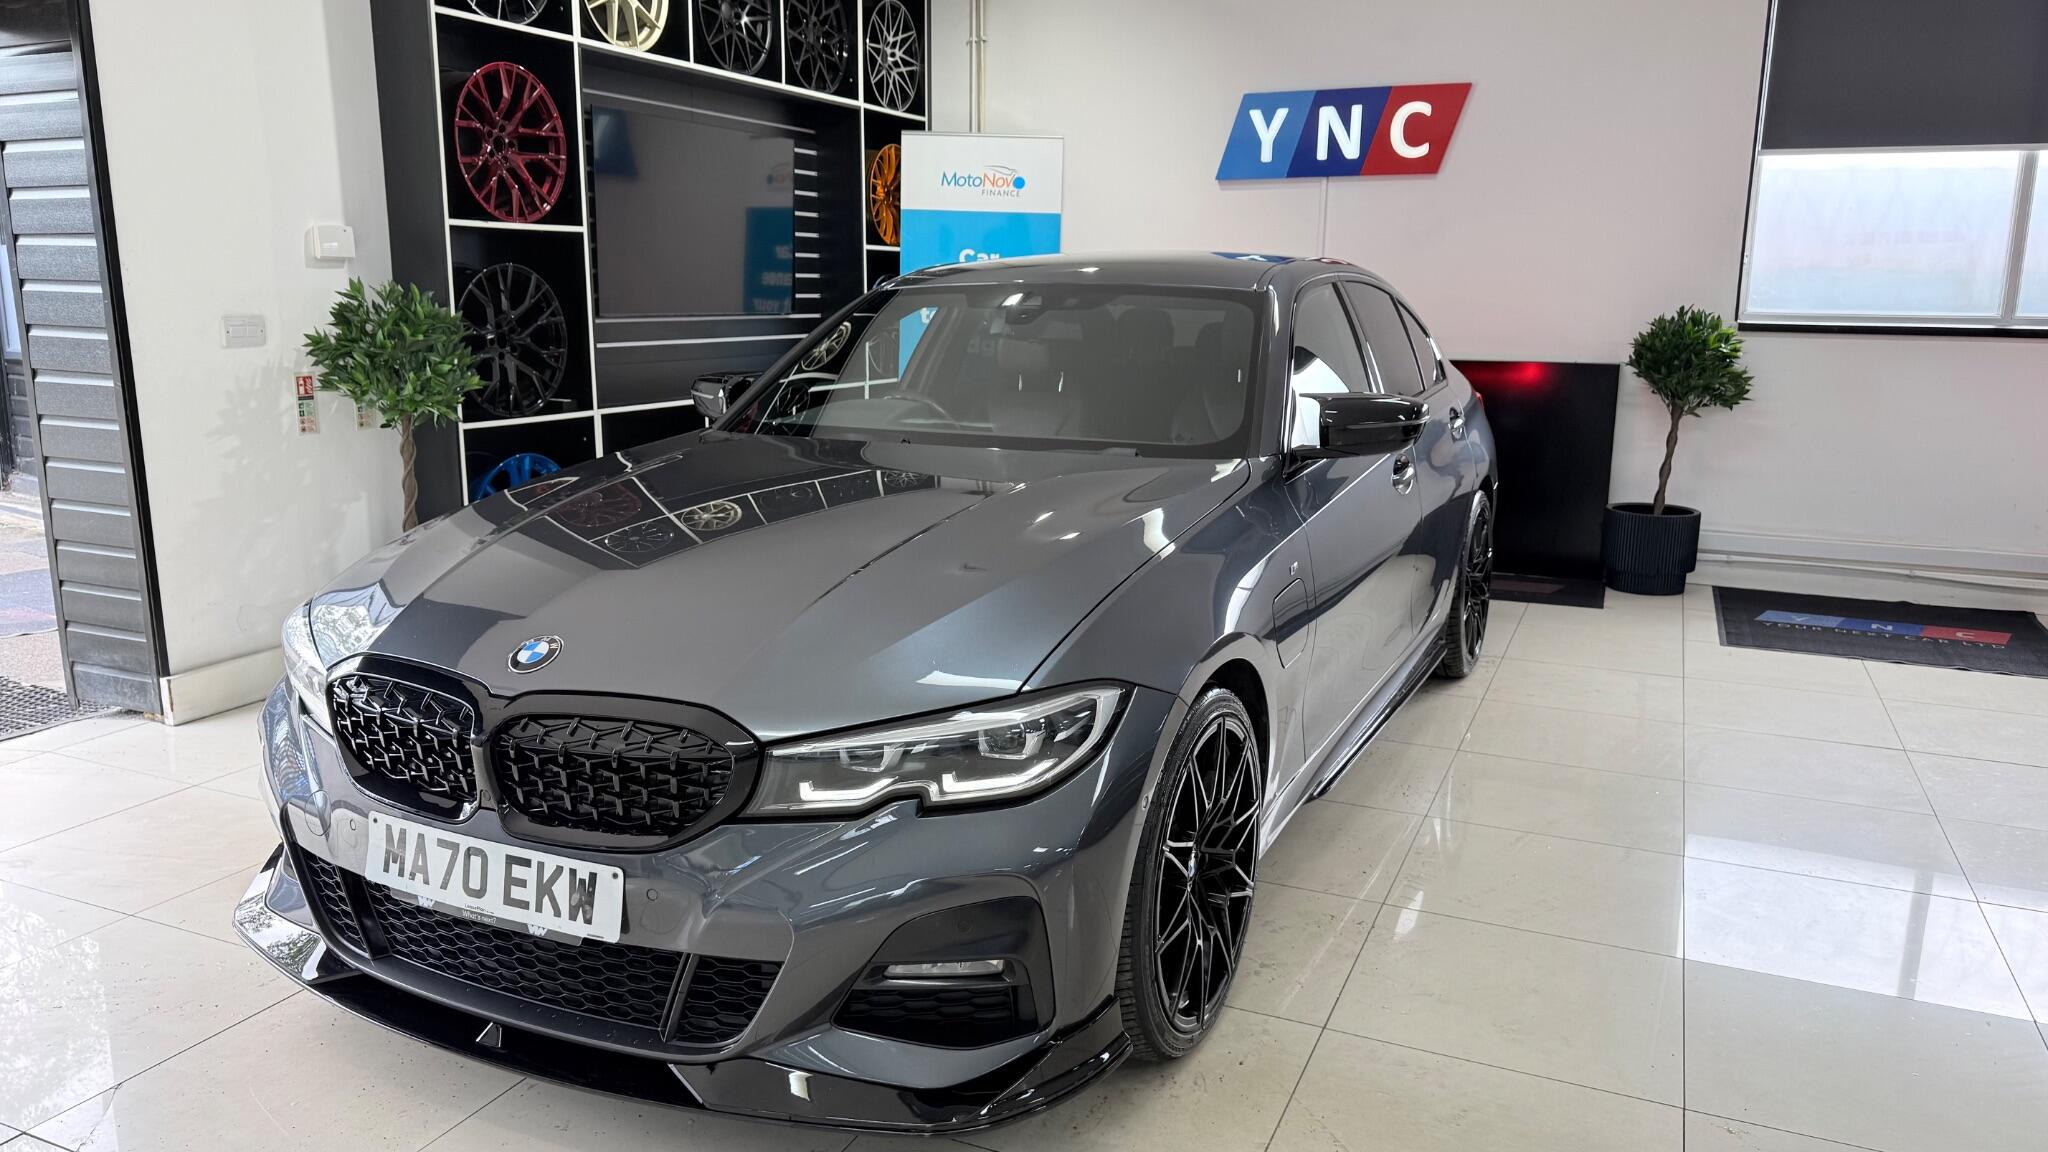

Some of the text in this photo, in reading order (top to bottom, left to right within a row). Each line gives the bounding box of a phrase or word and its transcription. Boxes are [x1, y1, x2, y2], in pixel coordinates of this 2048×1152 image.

[1249, 100, 1432, 163] YNC
[981, 189, 1020, 197] FINANCE
[383, 823, 598, 925] MA70 EKW
